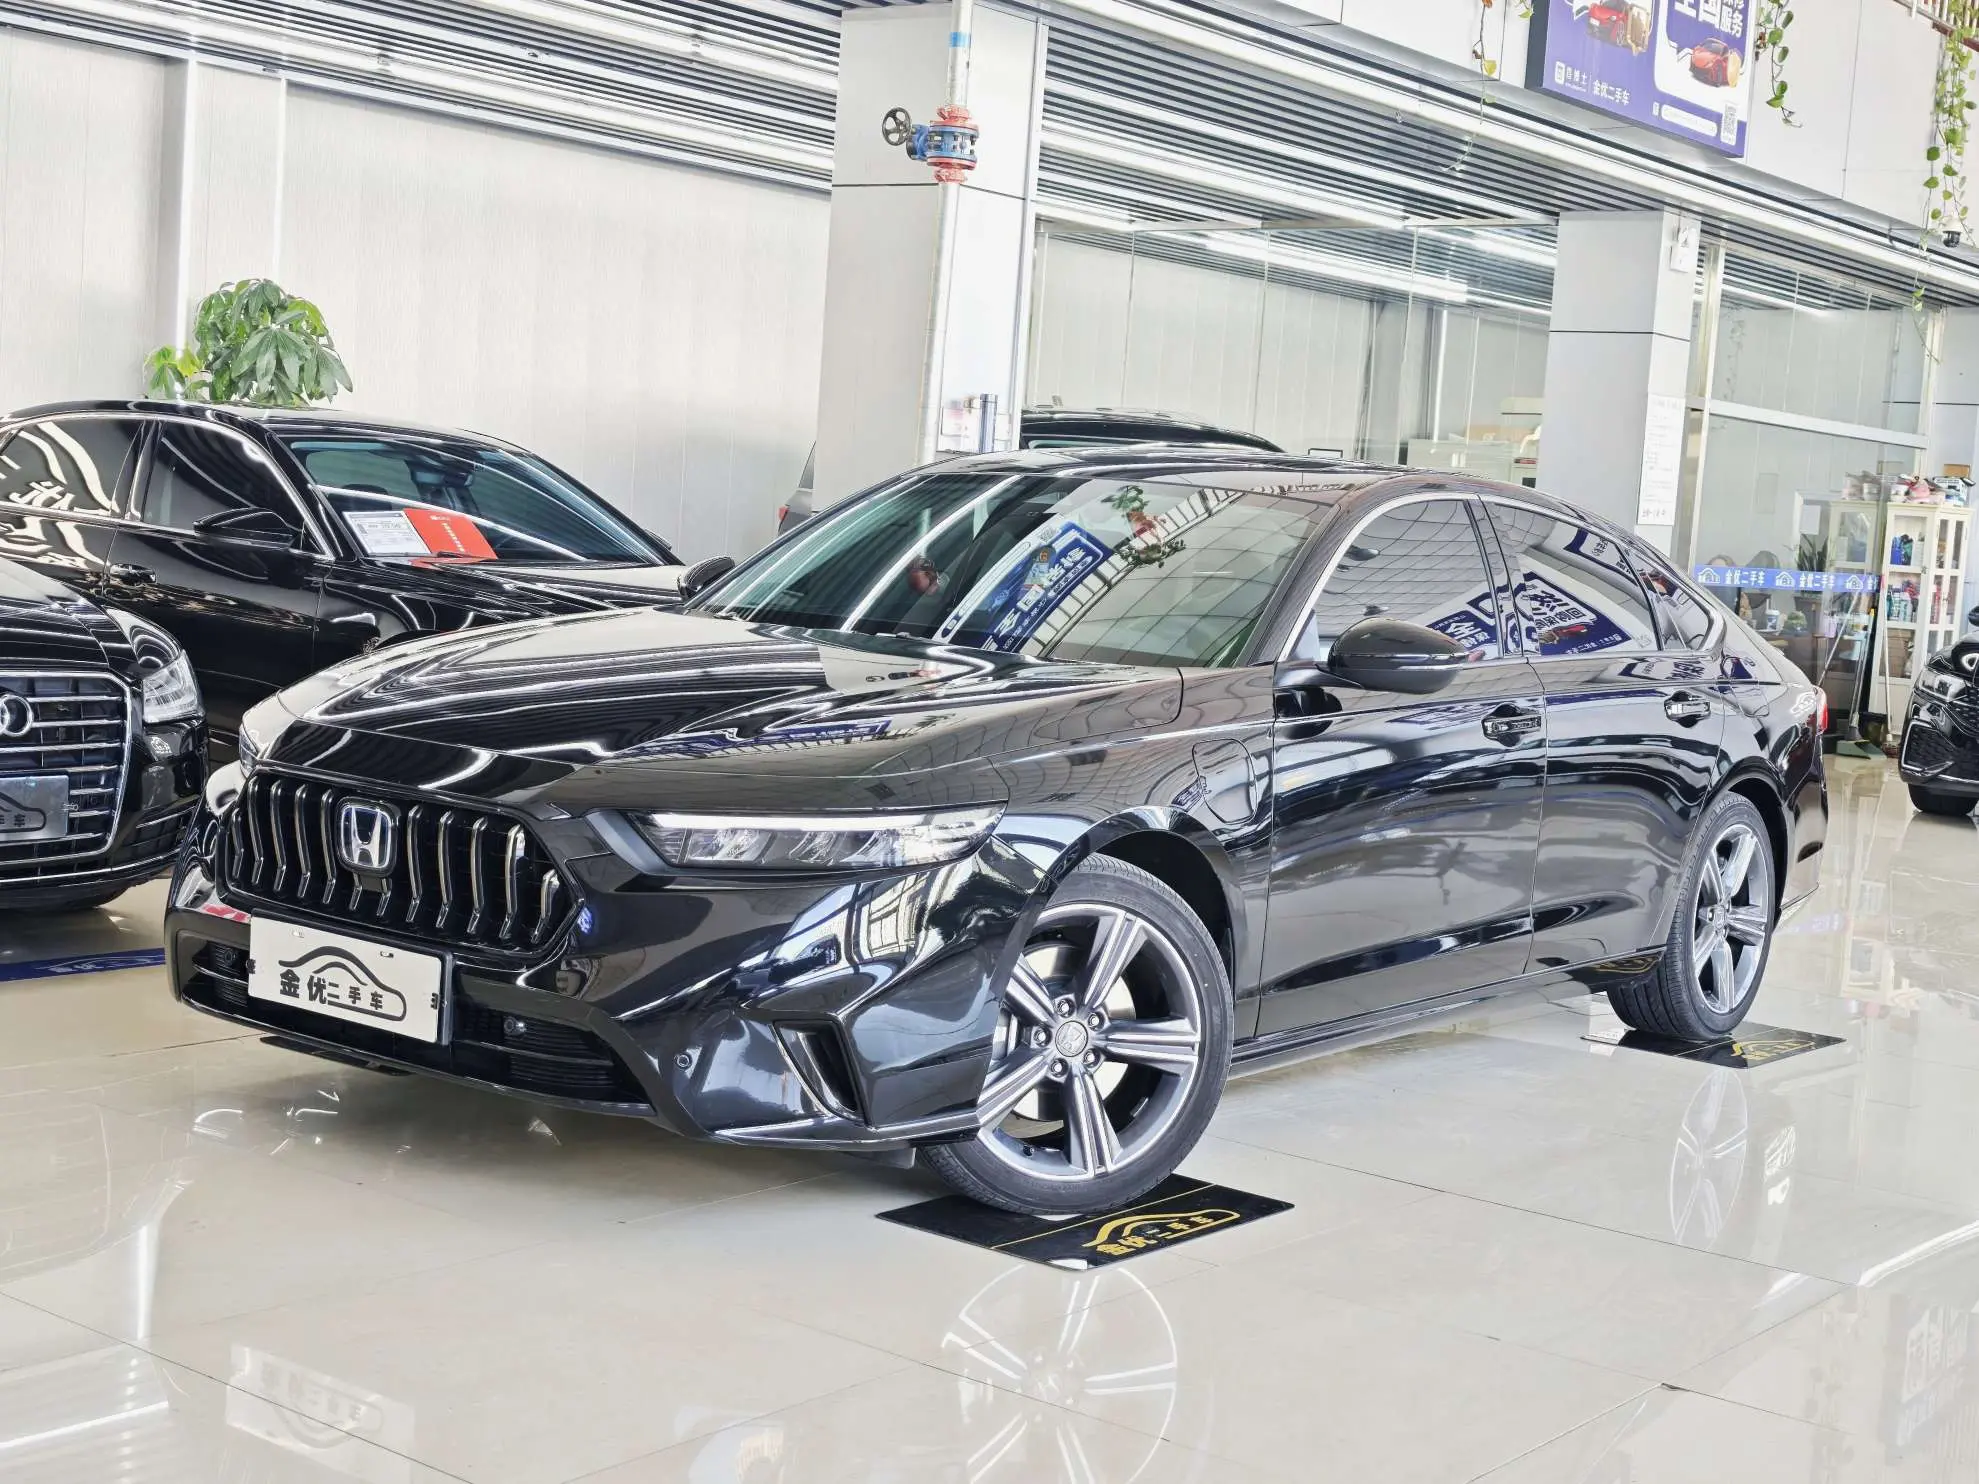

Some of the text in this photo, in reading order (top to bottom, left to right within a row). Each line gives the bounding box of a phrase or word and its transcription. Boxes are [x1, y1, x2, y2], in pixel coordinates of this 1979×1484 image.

[279, 968, 384, 1011] 金优二手车
